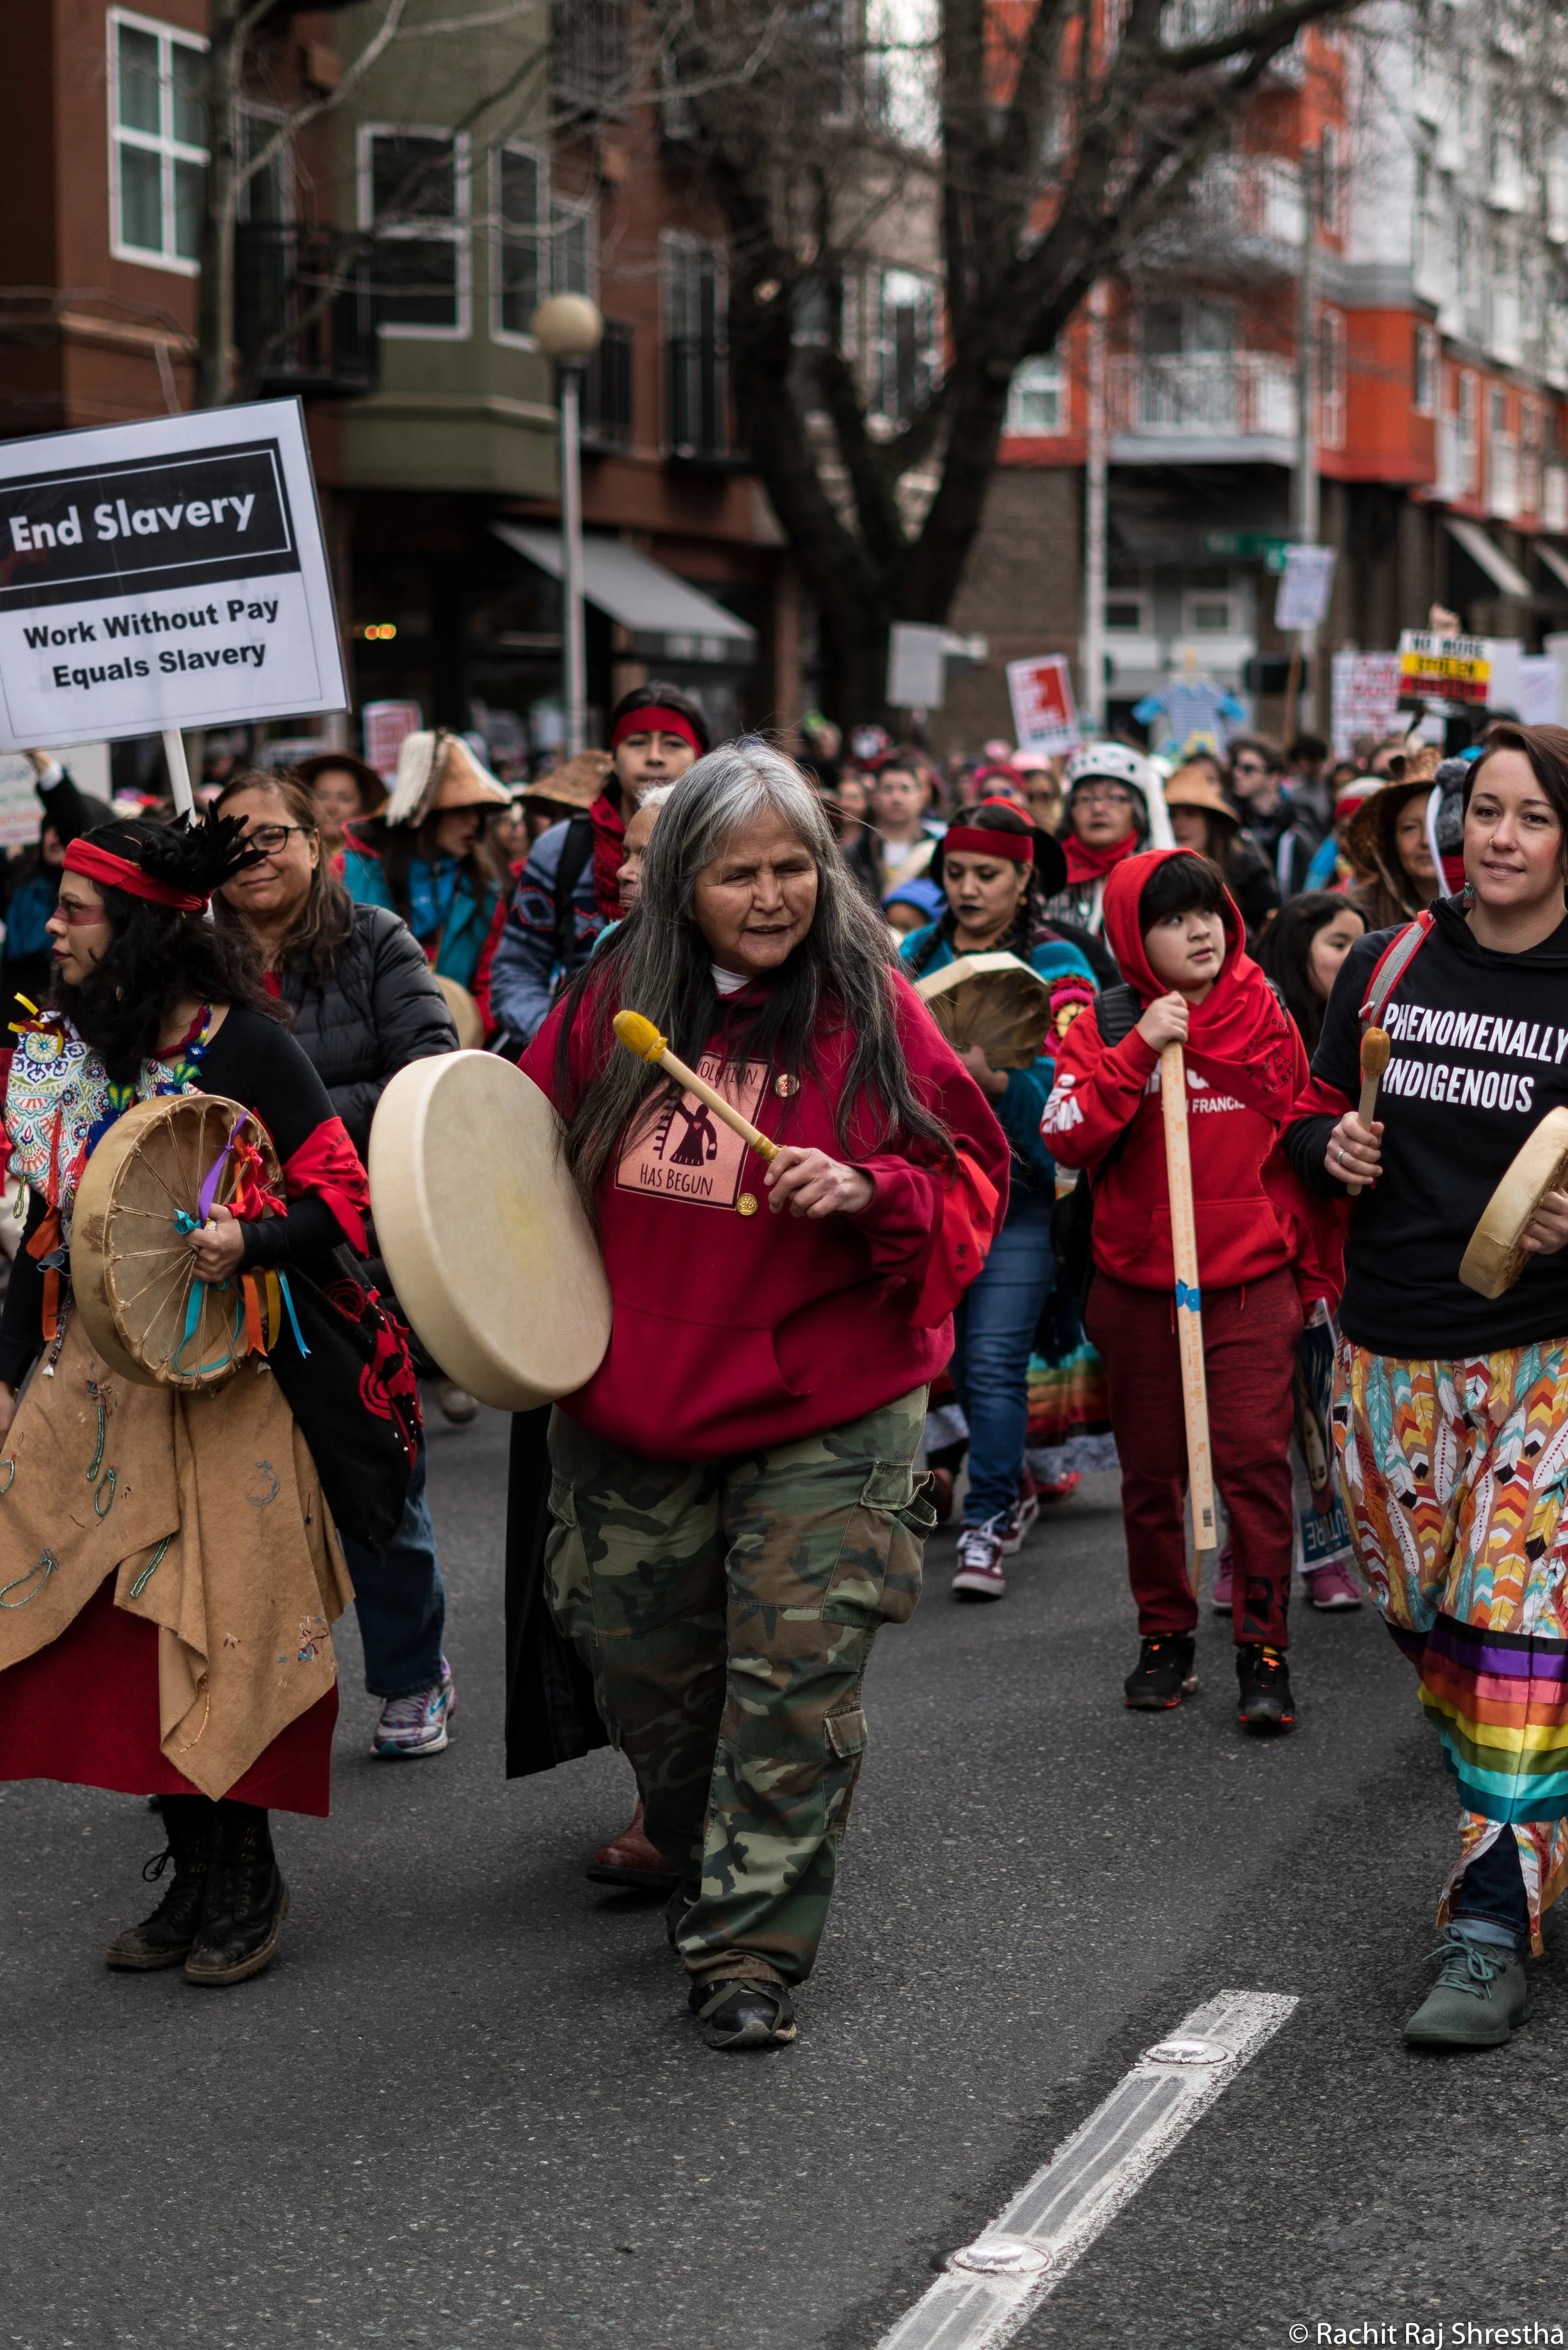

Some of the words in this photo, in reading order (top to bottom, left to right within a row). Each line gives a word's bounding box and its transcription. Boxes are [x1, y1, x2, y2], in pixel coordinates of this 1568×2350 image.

[9, 505, 83, 552] End
[94, 494, 255, 541] Slavery
[23, 622, 97, 648] Work
[103, 603, 218, 639] Without
[226, 599, 280, 623] Pay
[53, 657, 150, 690] Equals
[159, 643, 267, 674] Slavery
[1382, 1003, 1568, 1064] PHENOMENALLY
[1382, 1058, 1534, 1113] INDIGENOUS
[640, 1163, 663, 1187] HAS
[666, 1168, 714, 1196] BEGUN
[1305, 1508, 1348, 1552] UTURE
